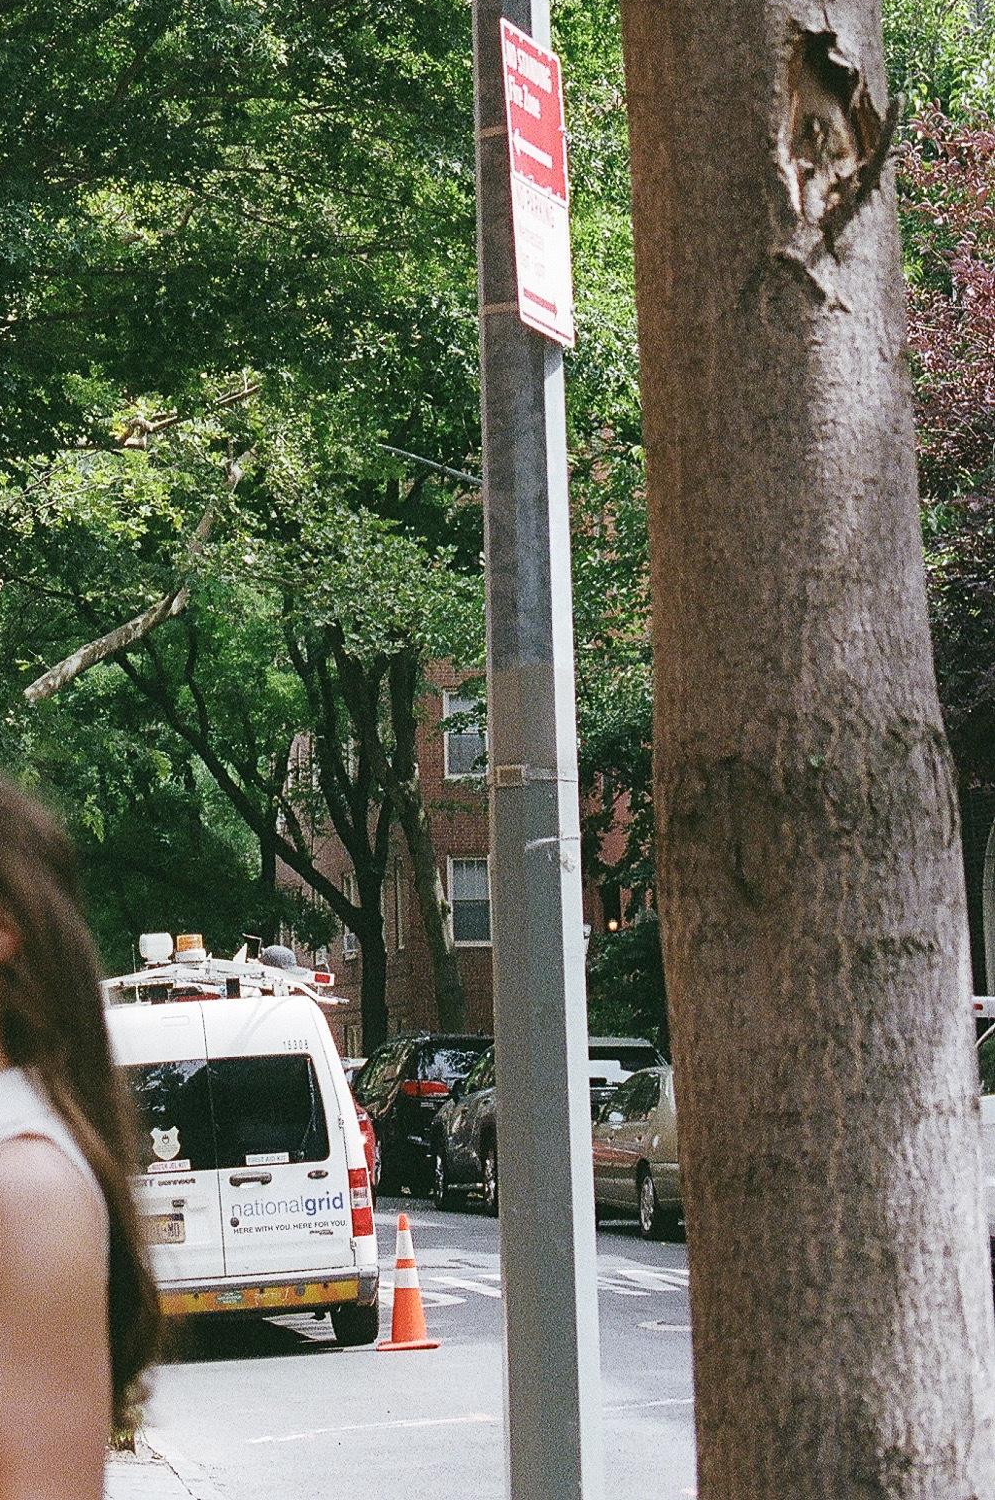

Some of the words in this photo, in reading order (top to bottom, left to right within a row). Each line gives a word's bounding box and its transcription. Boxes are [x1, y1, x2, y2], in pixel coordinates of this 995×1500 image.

[231, 1190, 344, 1217] nationalgrid
[233, 1226, 253, 1234] HERE
[255, 1224, 273, 1233] WITH
[293, 1222, 312, 1230] HERE
[314, 1220, 329, 1228] FOR
